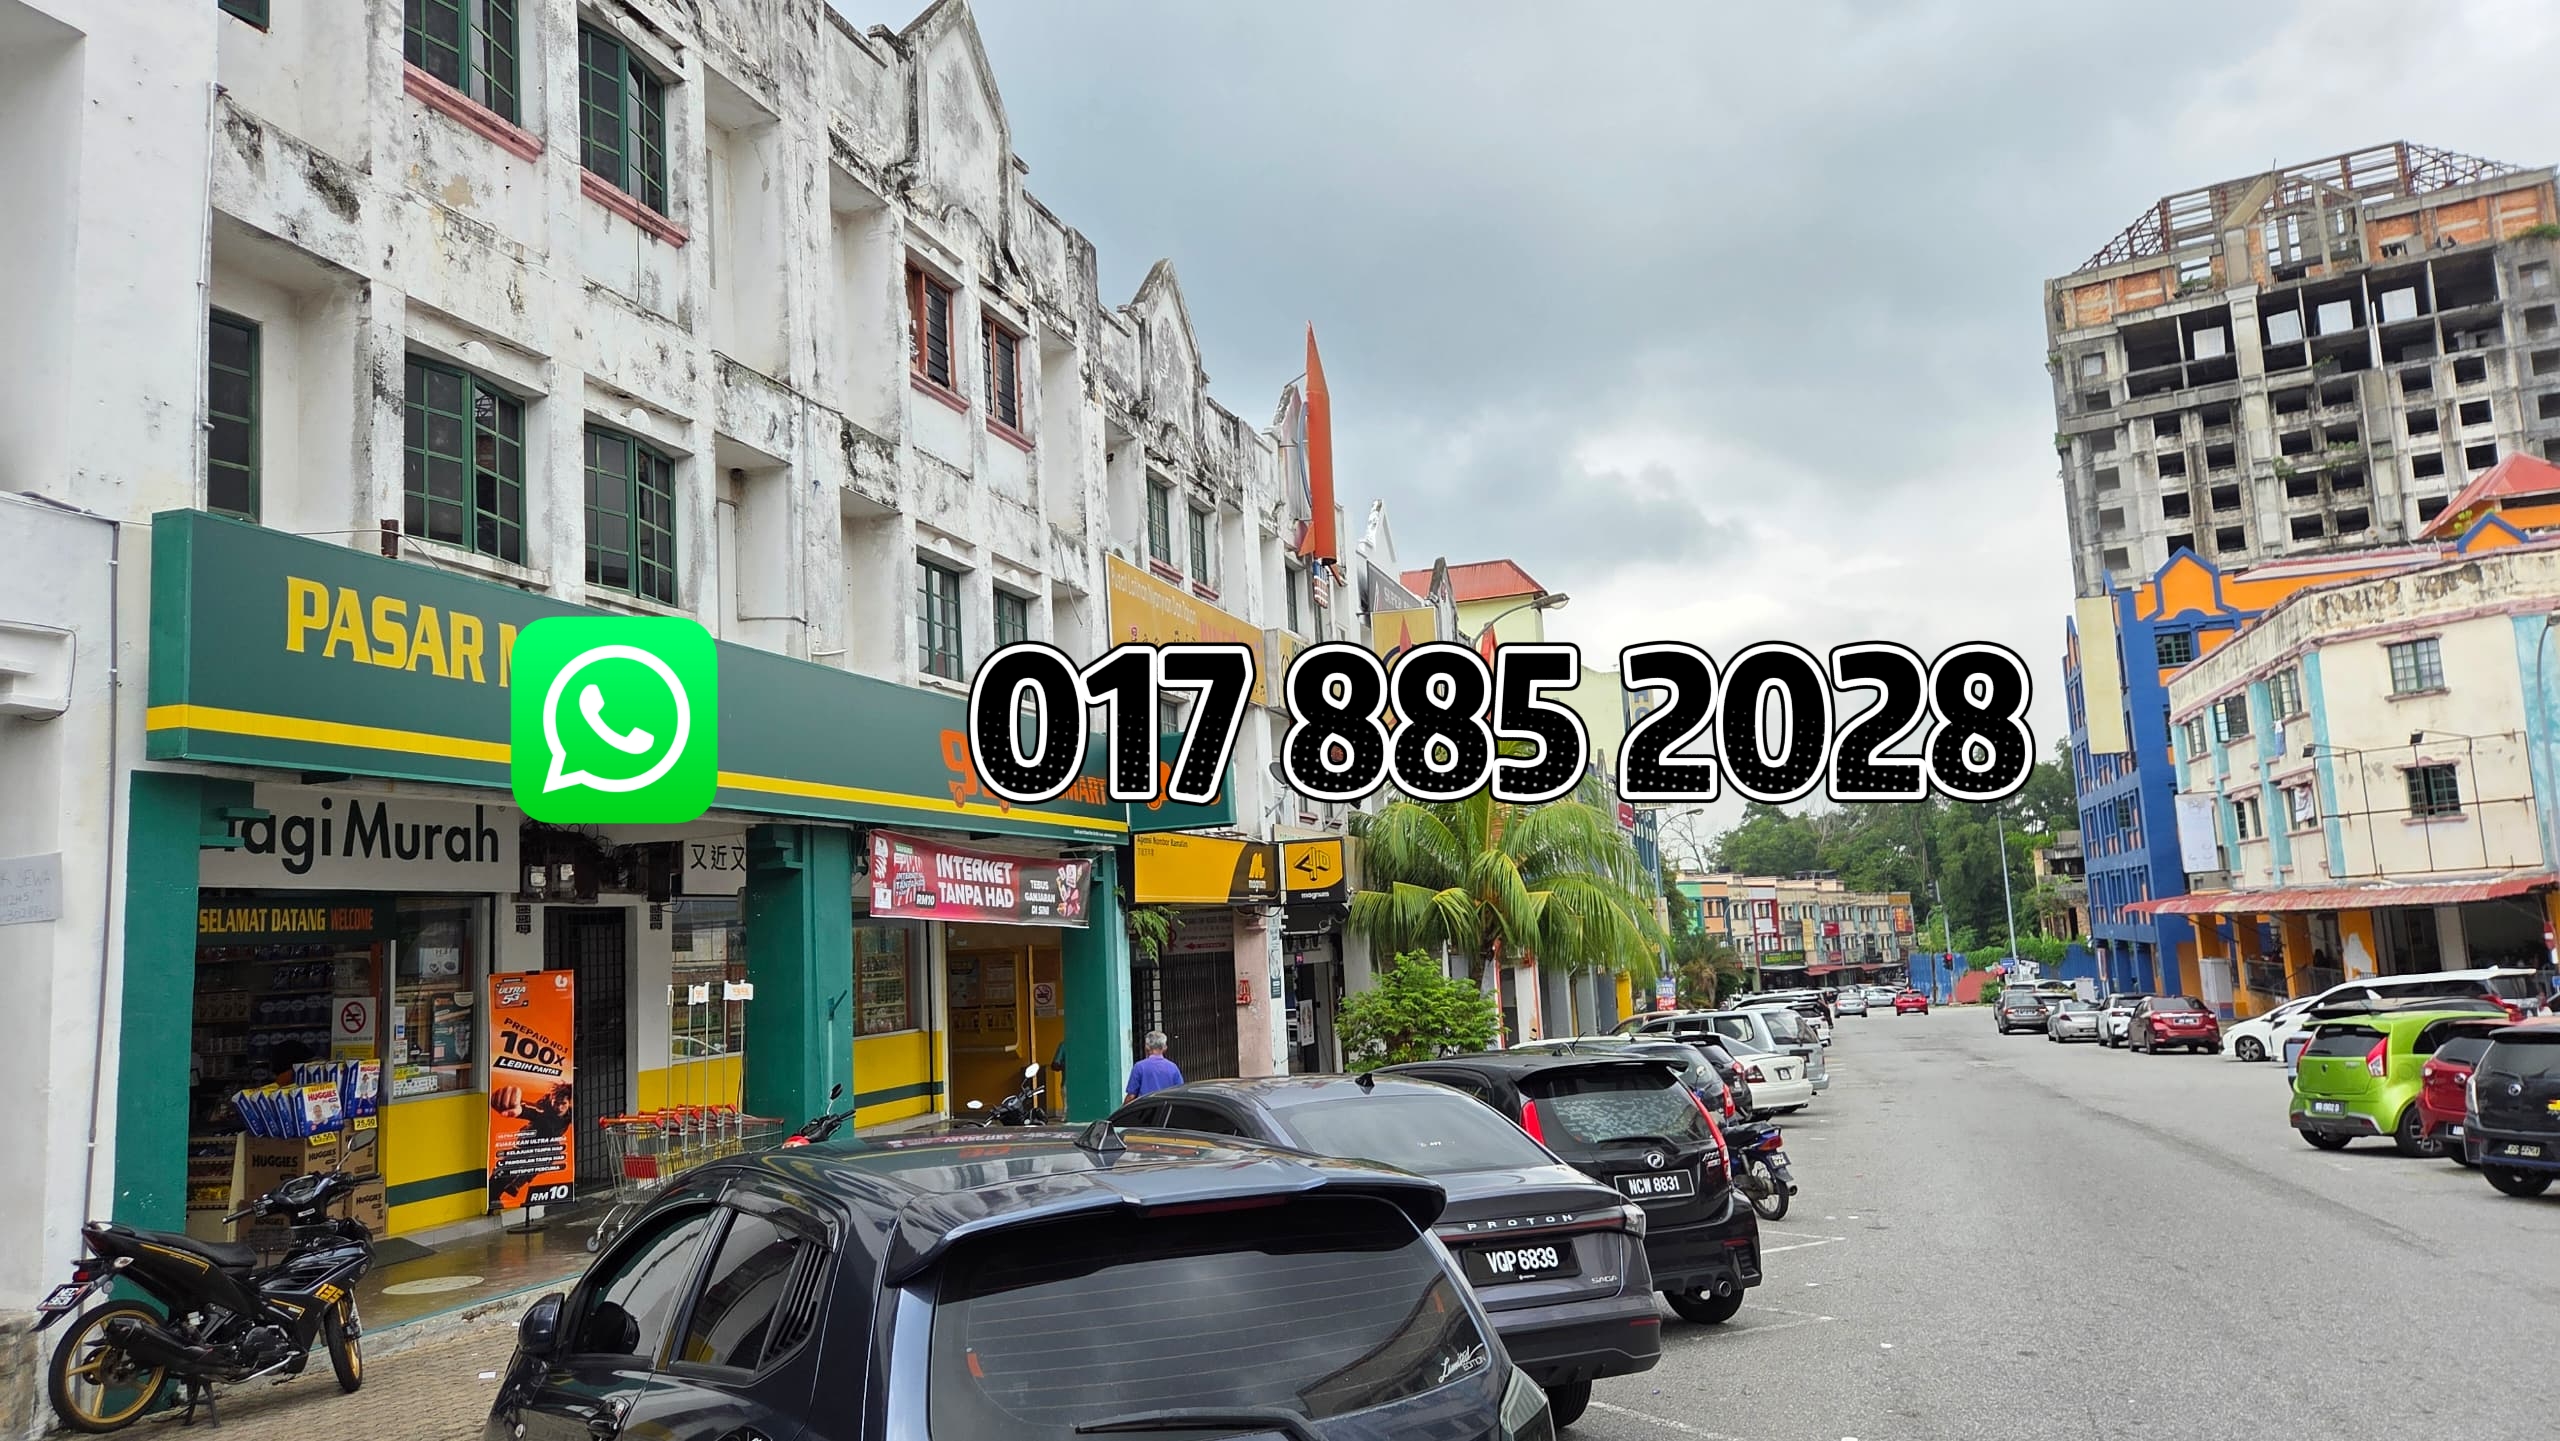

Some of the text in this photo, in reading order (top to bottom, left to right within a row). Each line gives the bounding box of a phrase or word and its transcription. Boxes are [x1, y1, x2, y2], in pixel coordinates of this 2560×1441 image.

[286, 576, 486, 684] PASAR
[342, 799, 499, 863] Murah
[691, 844, 746, 872] 又近又
[936, 853, 1014, 885] INTERNET
[1030, 879, 1049, 890] TEBUS
[916, 893, 935, 906] RM10
[938, 882, 1015, 908] TANPA HAD
[1025, 892, 1056, 903] GANJARAN
[1301, 891, 1329, 901] magnum
[200, 908, 374, 933] SELAMAT DATANG WELCOME
[498, 985, 527, 995] ULTRA
[501, 994, 521, 1005] 5G
[504, 1017, 569, 1054] PREPAID NO.1
[499, 1058, 560, 1076] LEBIH PANTAS
[307, 1090, 337, 1101] HUGGIES
[252, 1154, 299, 1168] HUGGIES
[308, 1149, 337, 1161] HUGGIES
[530, 1185, 569, 1202] RM10
[1628, 1175, 1680, 1196] NCW 8831
[1467, 1214, 1575, 1231] PROTON
[1485, 1246, 1559, 1274] VQP 6839
[1591, 1274, 1619, 1284] SAGA
